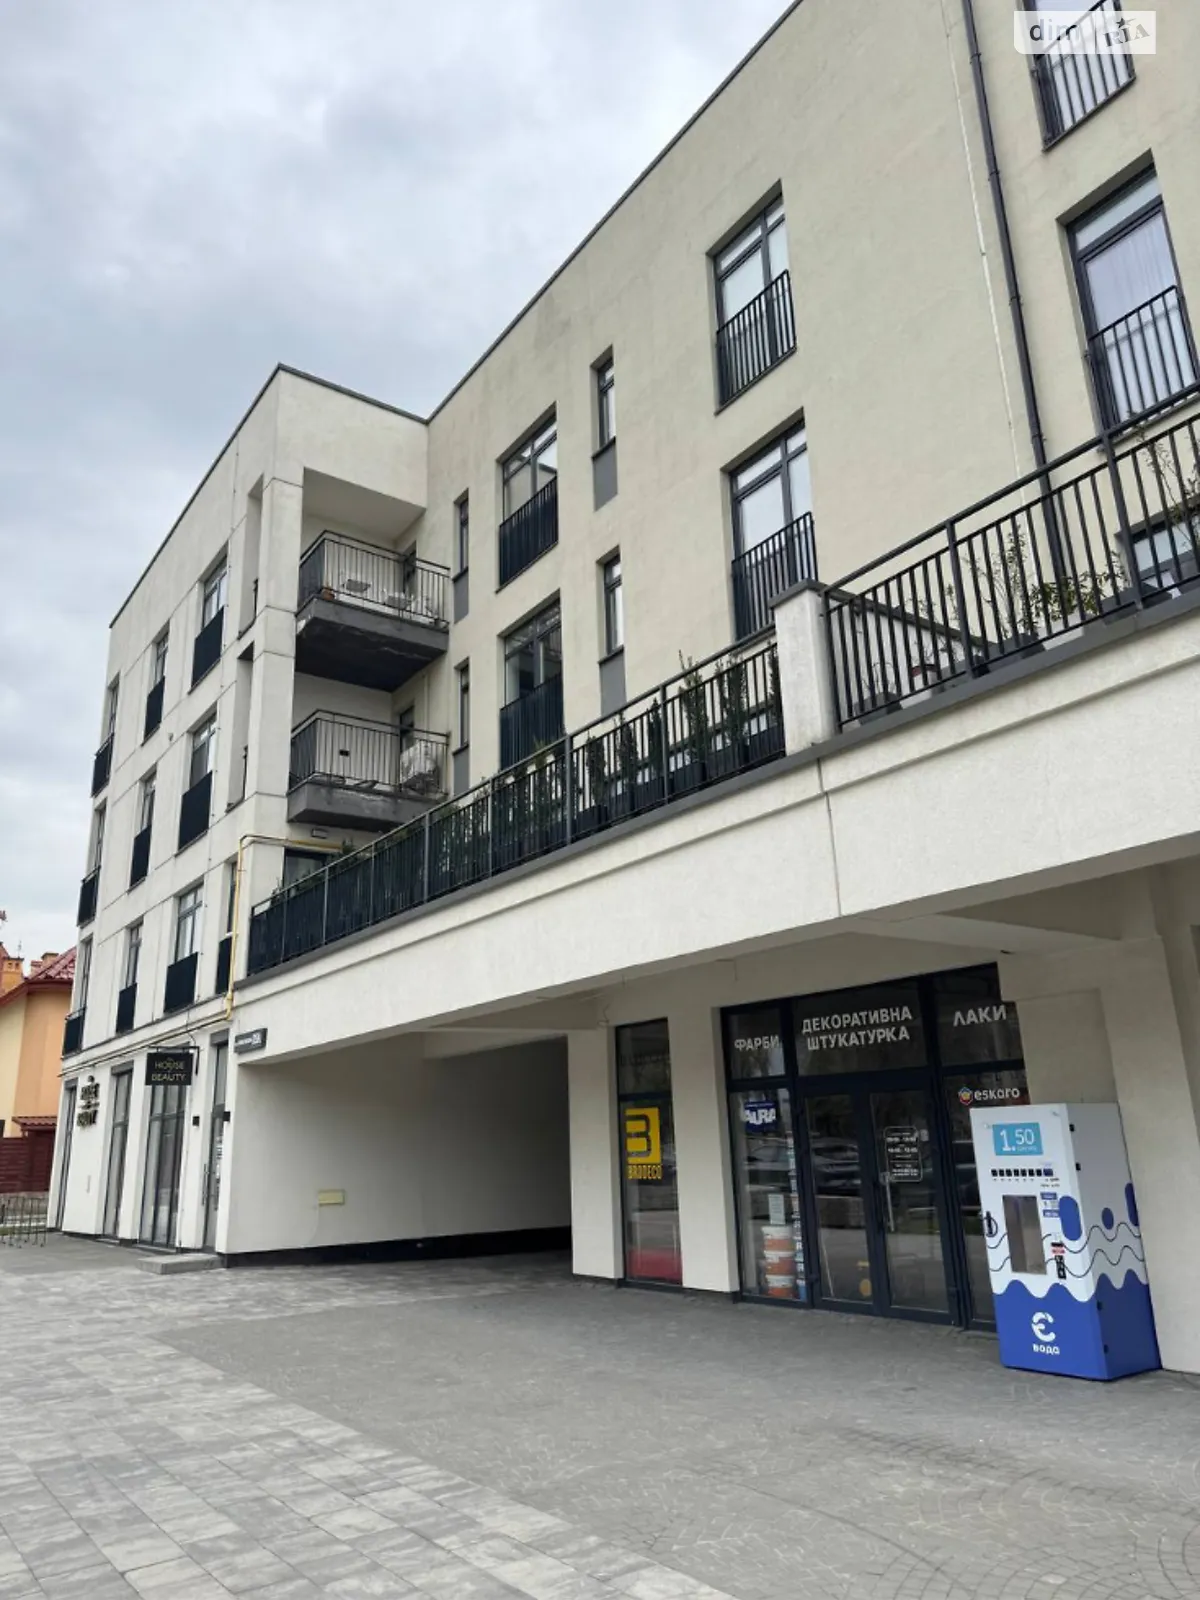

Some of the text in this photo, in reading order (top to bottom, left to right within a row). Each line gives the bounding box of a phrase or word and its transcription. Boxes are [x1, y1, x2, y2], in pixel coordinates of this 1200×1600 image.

[801, 1005, 912, 1034] ДЕКОРАТИВНА
[953, 1005, 1007, 1027] ЛАКИ
[734, 1034, 780, 1051] ФАРБИ
[807, 1025, 910, 1051] ШТУКАТУРКА
[151, 1073, 187, 1082] BEAUTY
[974, 1087, 1020, 1101] eskaro
